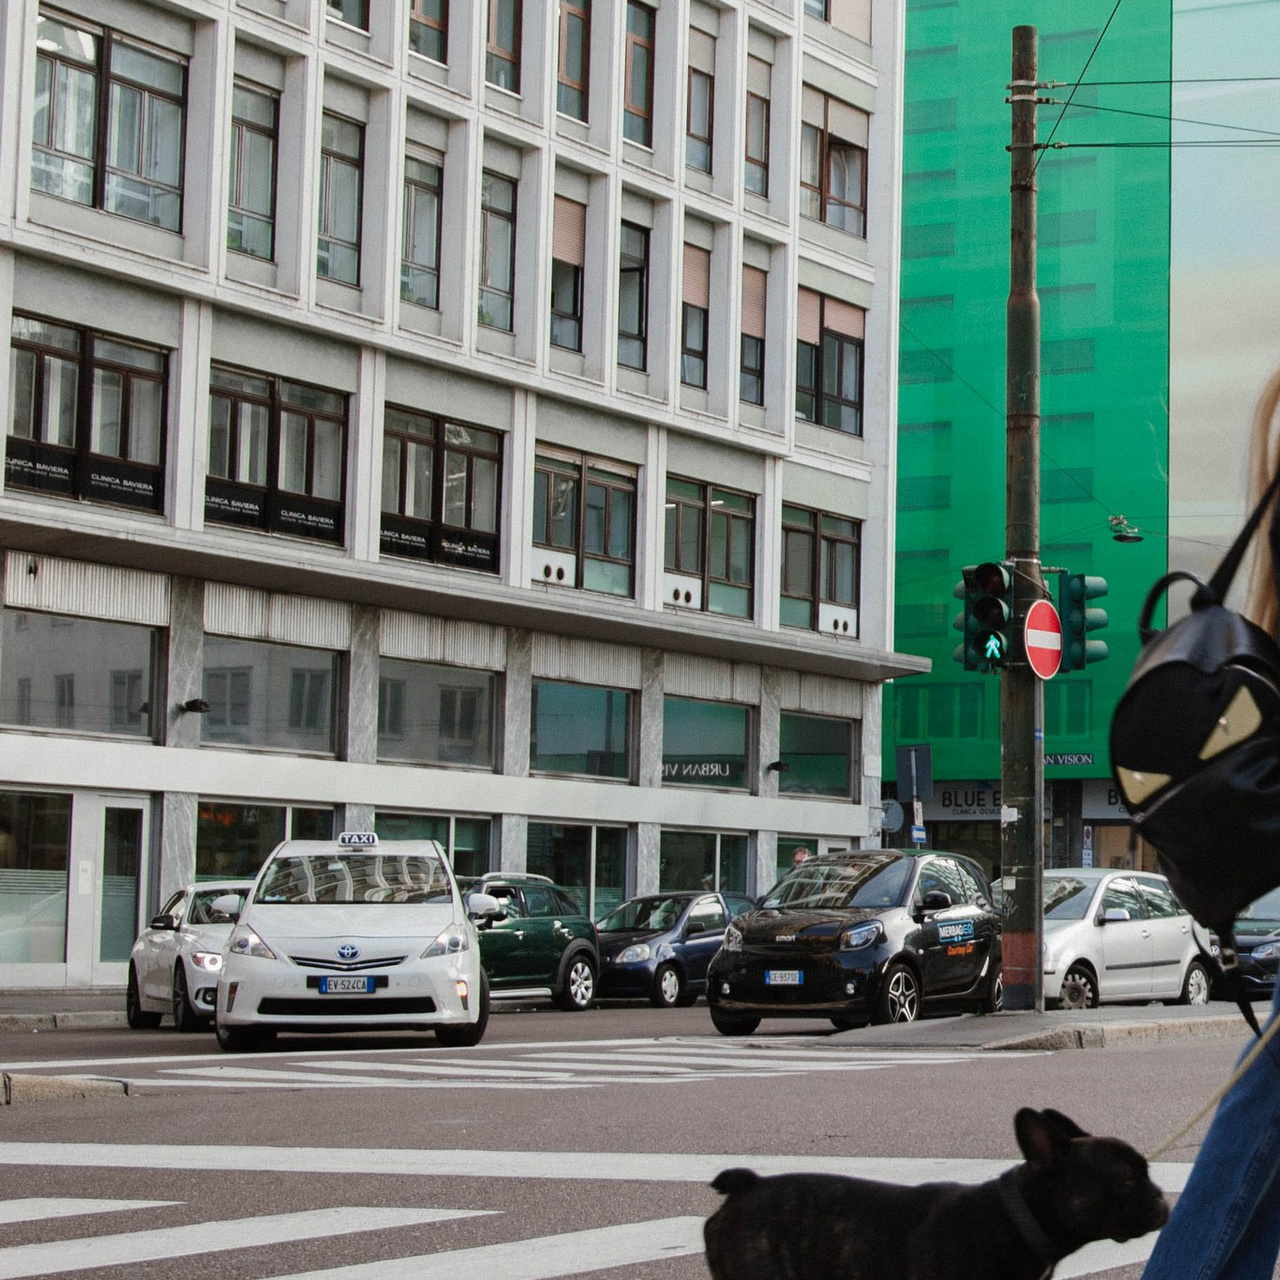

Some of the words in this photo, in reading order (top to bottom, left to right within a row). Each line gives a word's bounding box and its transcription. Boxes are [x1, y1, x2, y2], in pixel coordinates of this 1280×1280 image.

[36, 463, 69, 475] BAVIERA
[91, 473, 120, 484] CLINICA
[123, 479, 154, 491] BAVIERA
[231, 500, 259, 510] BAVIERA
[281, 510, 305, 519] CLINICA
[308, 515, 334, 525] BAVIERA
[380, 530, 399, 538] LINICA
[401, 533, 426, 543] BAVIERA
[1057, 754, 1093, 765] VISION
[942, 790, 986, 807] BLUE
[343, 834, 373, 844] TAXI
